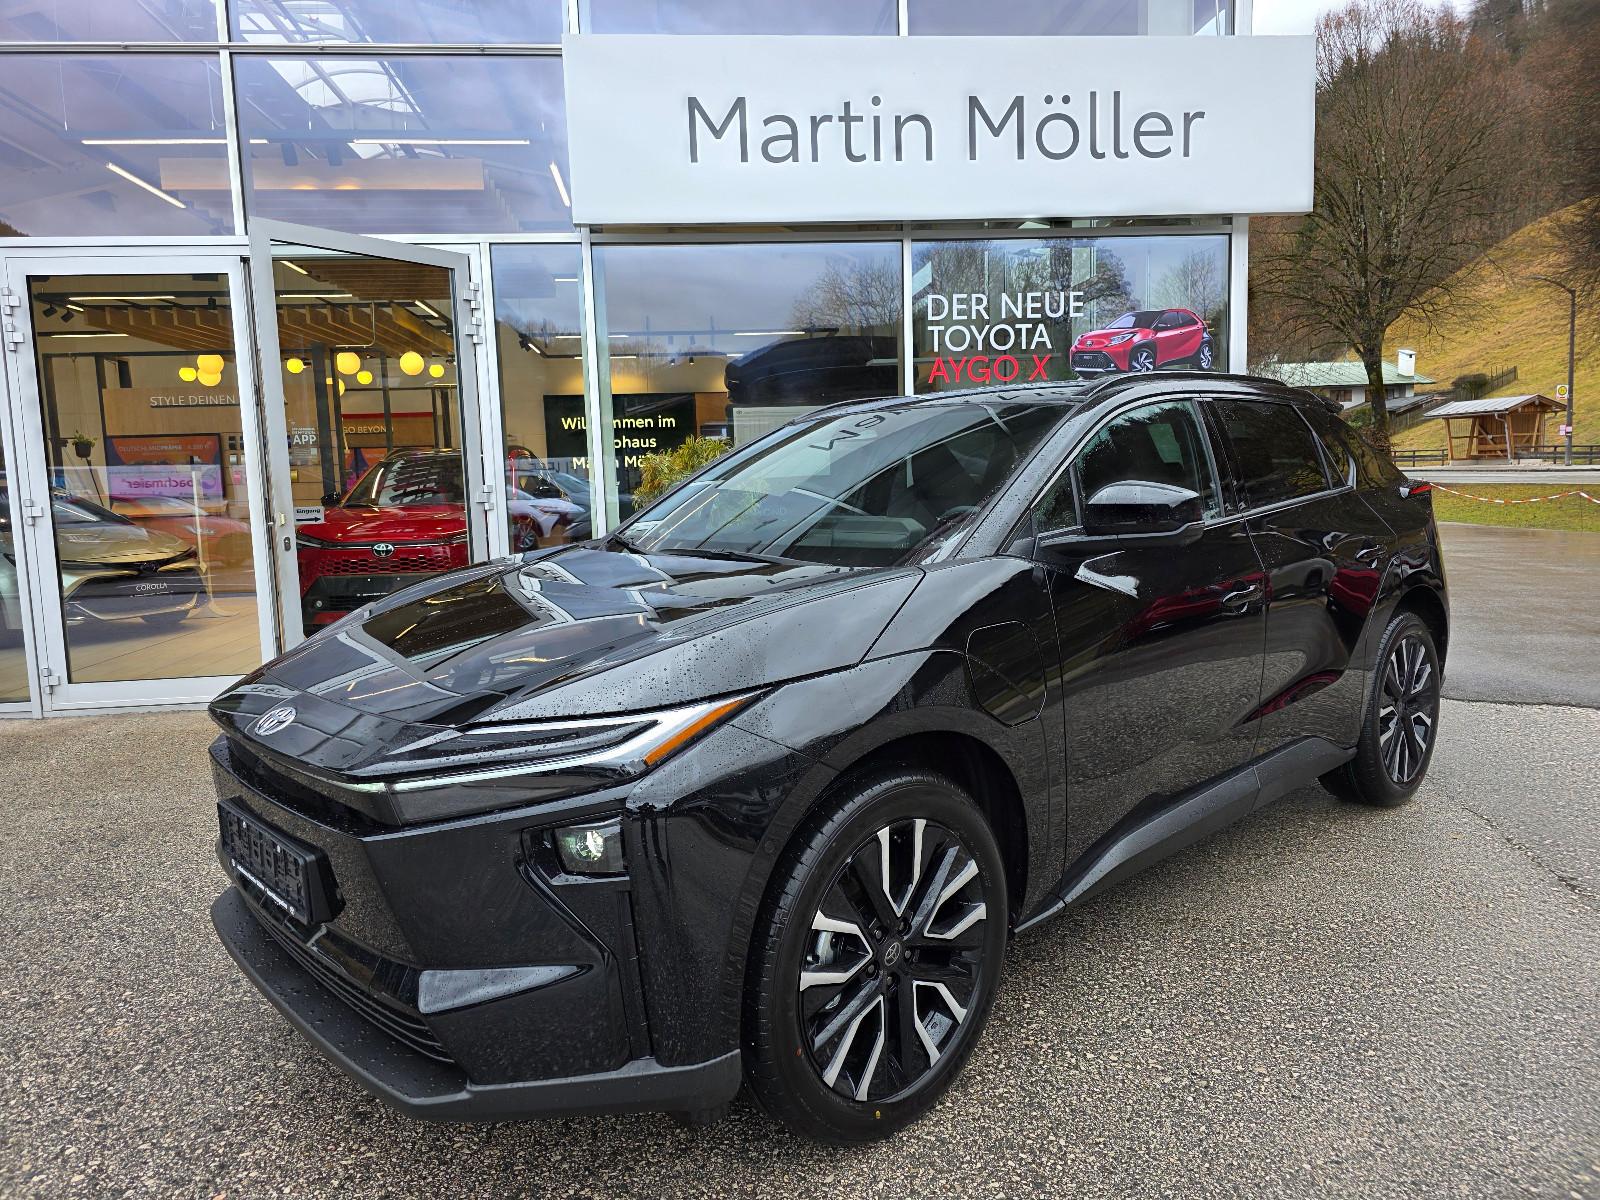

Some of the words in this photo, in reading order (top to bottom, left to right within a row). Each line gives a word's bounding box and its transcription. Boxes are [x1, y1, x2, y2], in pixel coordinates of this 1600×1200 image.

[687, 96, 933, 163] Martin
[968, 91, 1206, 161] Möller
[927, 293, 990, 321] DER
[1001, 291, 1085, 318] NEUE
[927, 322, 1053, 353] TOYOTA
[928, 354, 1019, 384] AYGO
[1028, 353, 1052, 382] X
[150, 396, 185, 407] STYLE
[188, 394, 236, 405] DEINEN
[658, 414, 676, 428] im
[292, 434, 317, 445] APP
[135, 582, 168, 592] COROLLA
